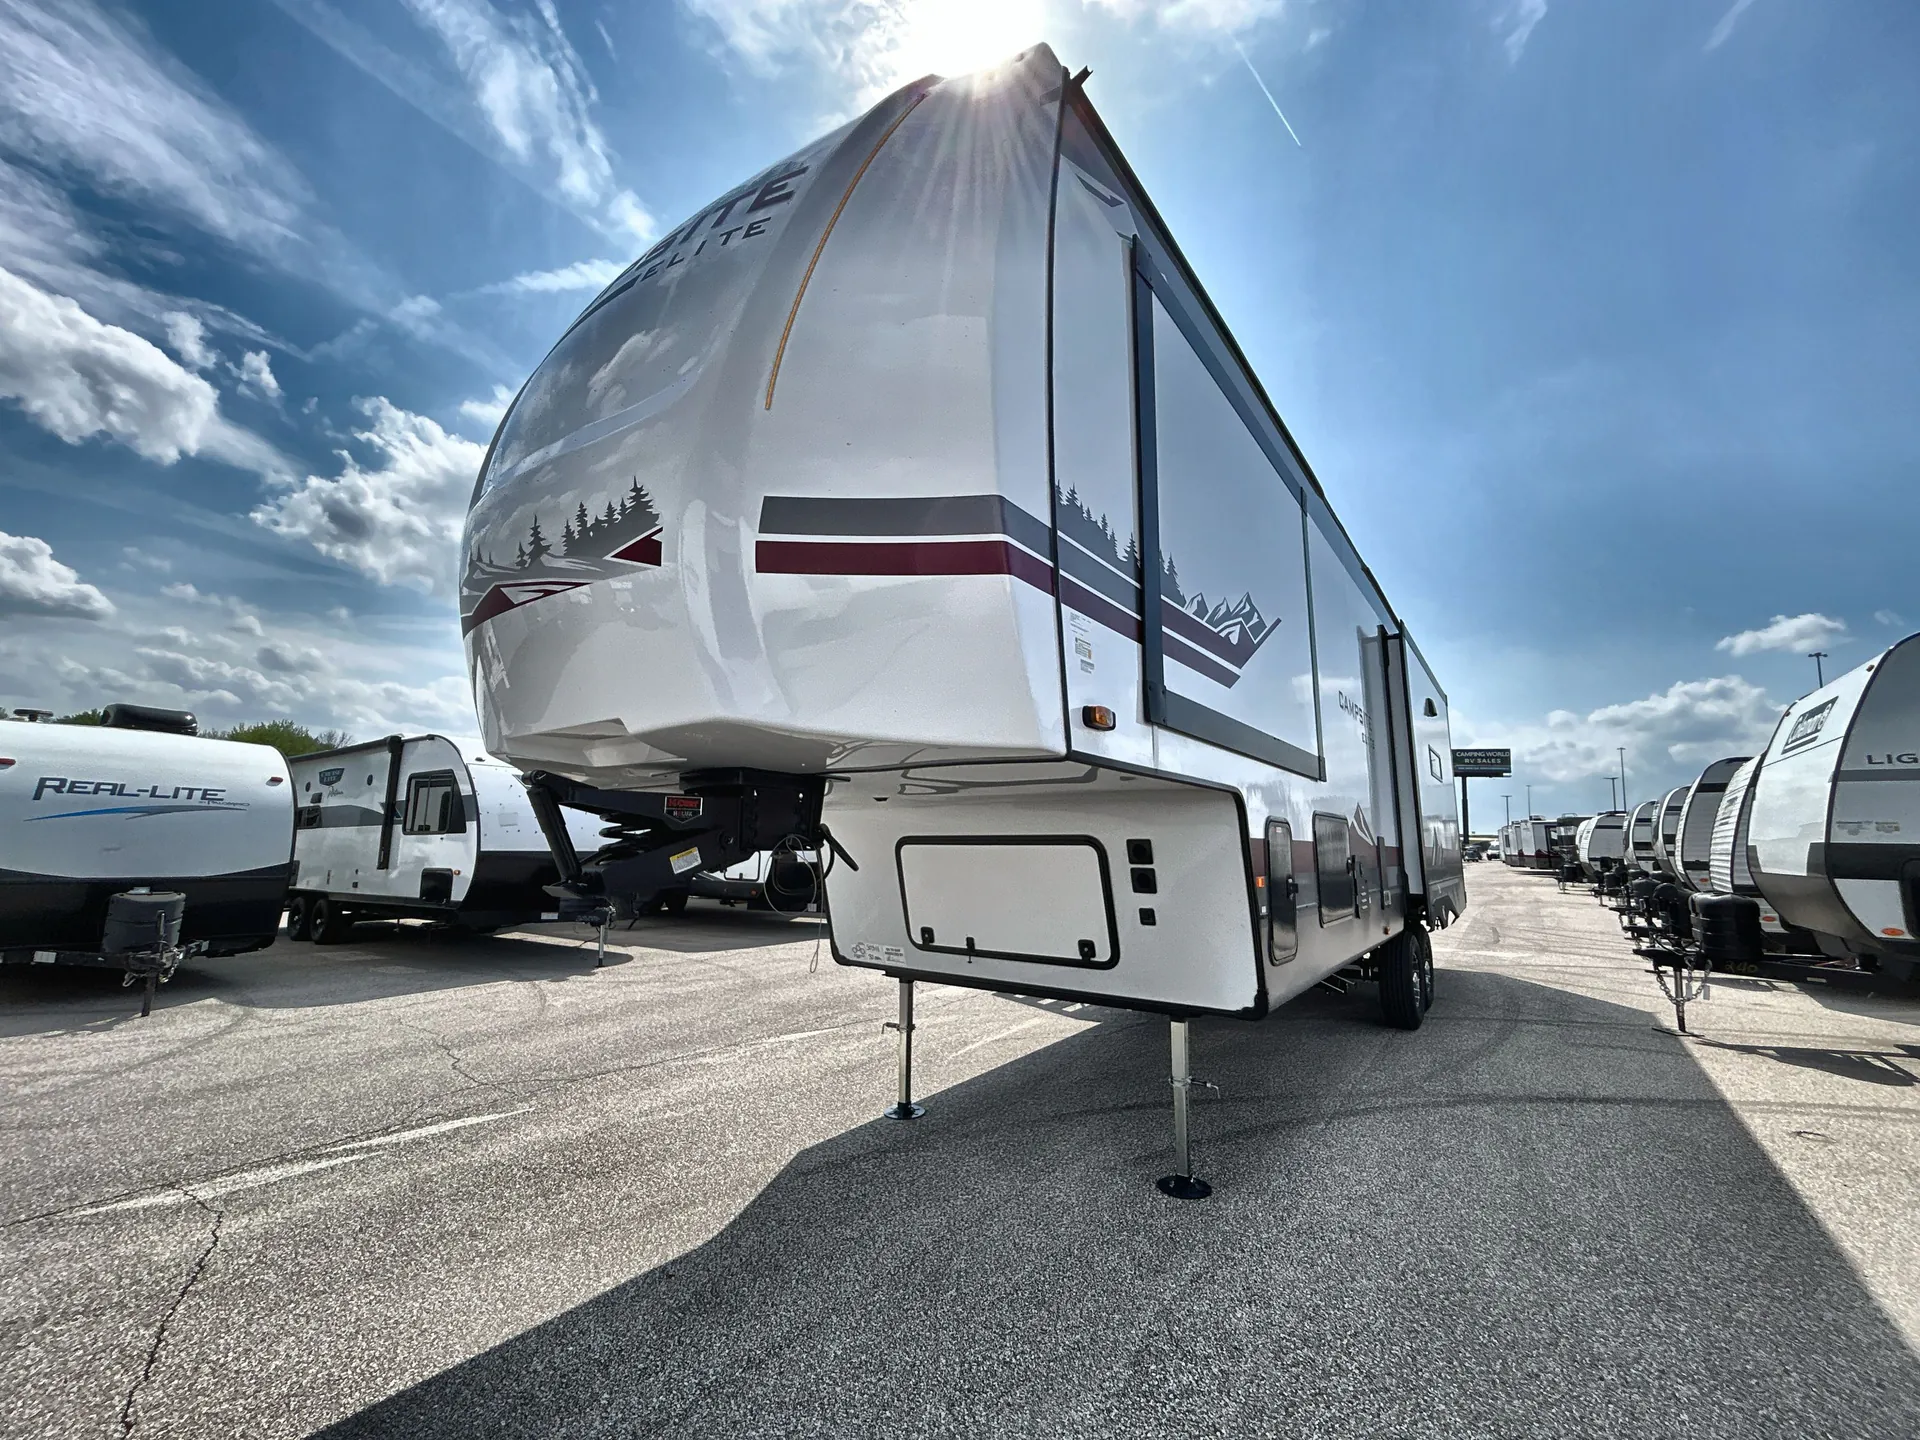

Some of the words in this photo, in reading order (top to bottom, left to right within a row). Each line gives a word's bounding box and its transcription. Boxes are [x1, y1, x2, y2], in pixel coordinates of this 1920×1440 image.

[622, 165, 809, 279] SITE
[641, 216, 771, 282] ELITE
[1866, 753, 1919, 765] LIG
[32, 776, 227, 801] REAL-LITE
